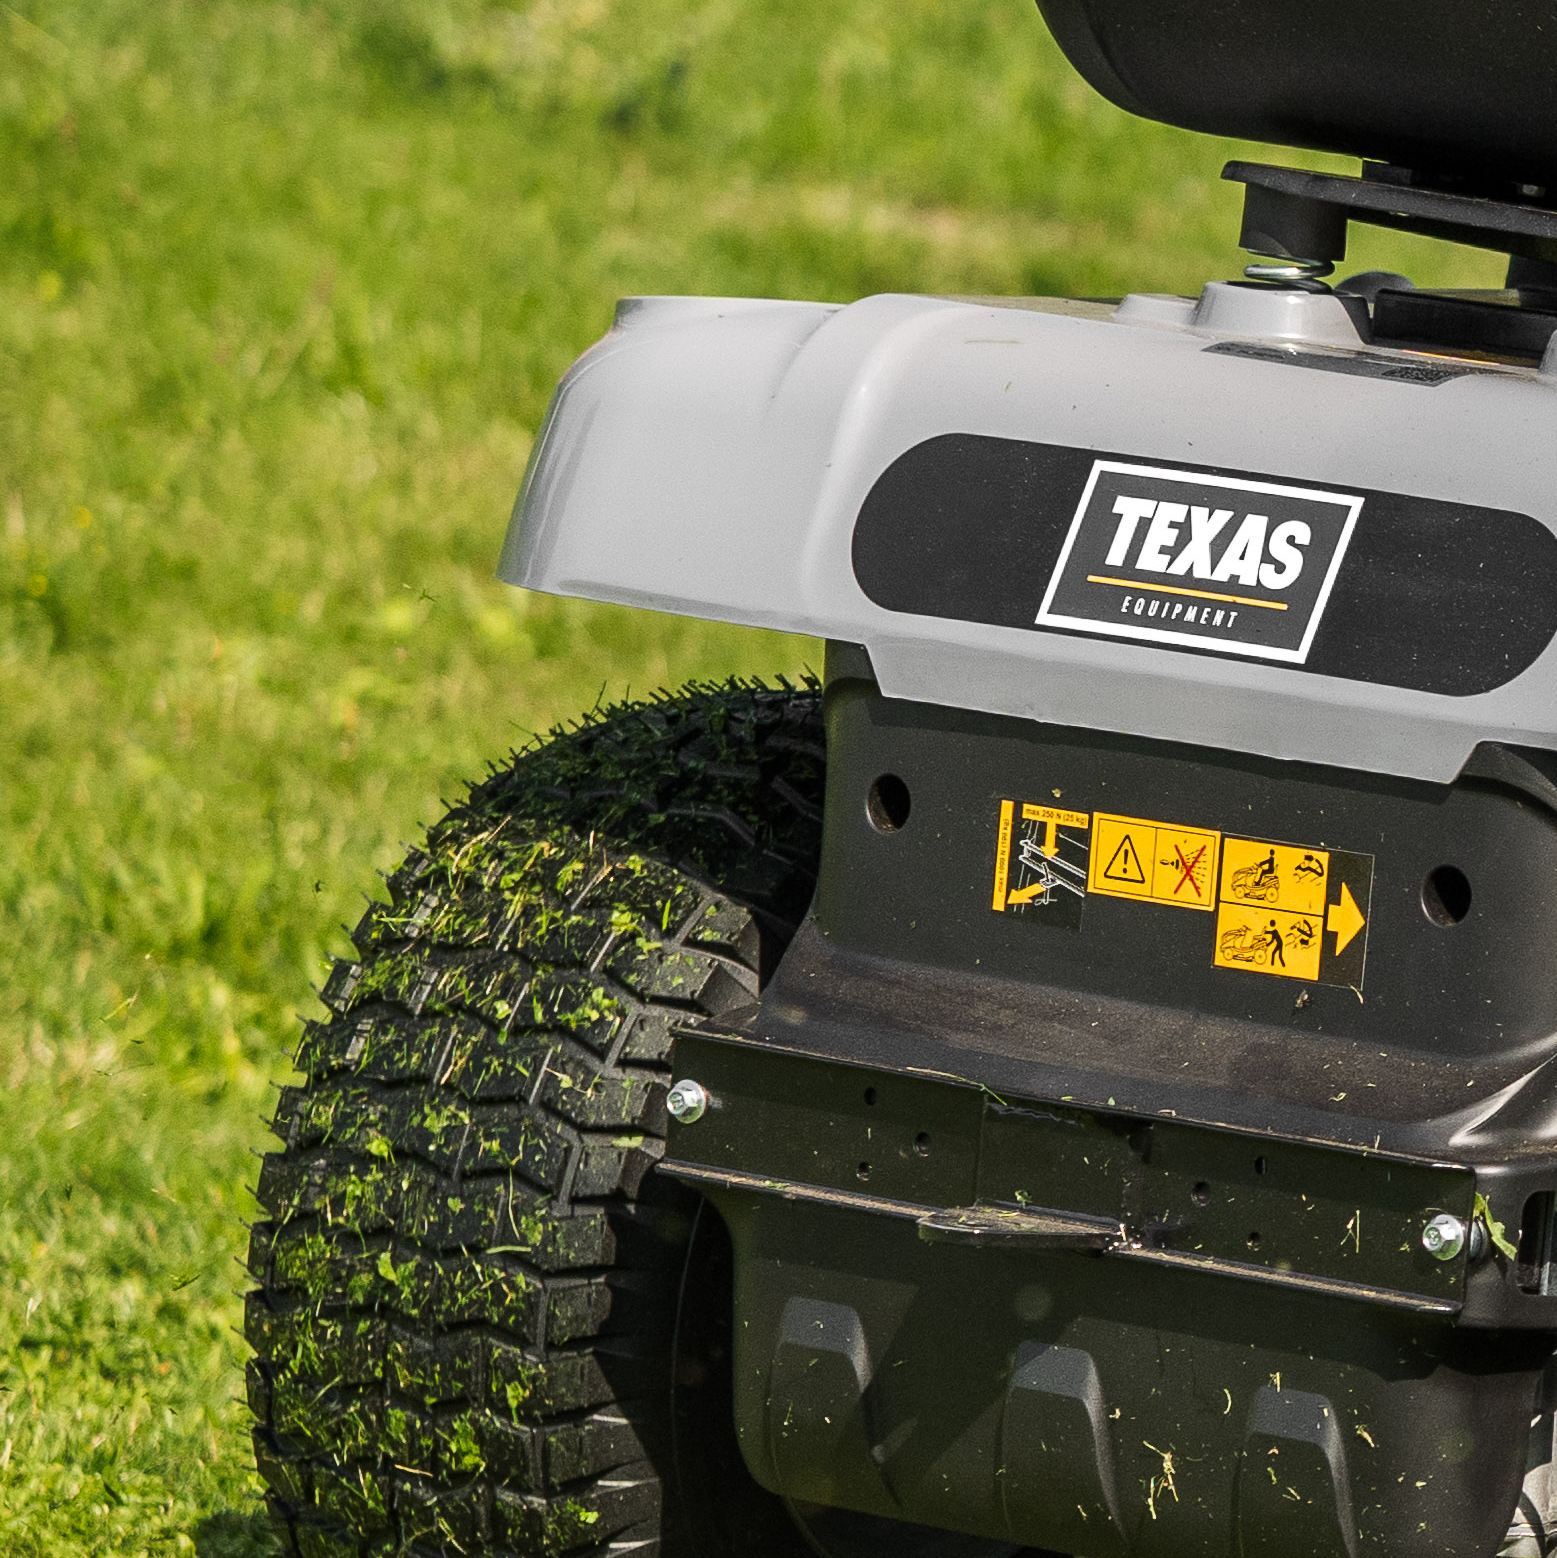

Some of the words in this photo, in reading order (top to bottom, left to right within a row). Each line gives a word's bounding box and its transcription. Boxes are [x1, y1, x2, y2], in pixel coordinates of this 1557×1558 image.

[1105, 495, 1312, 590] TEXAS
[1121, 596, 1239, 628] EQUIPMENT
[1041, 809, 1055, 819] 250
